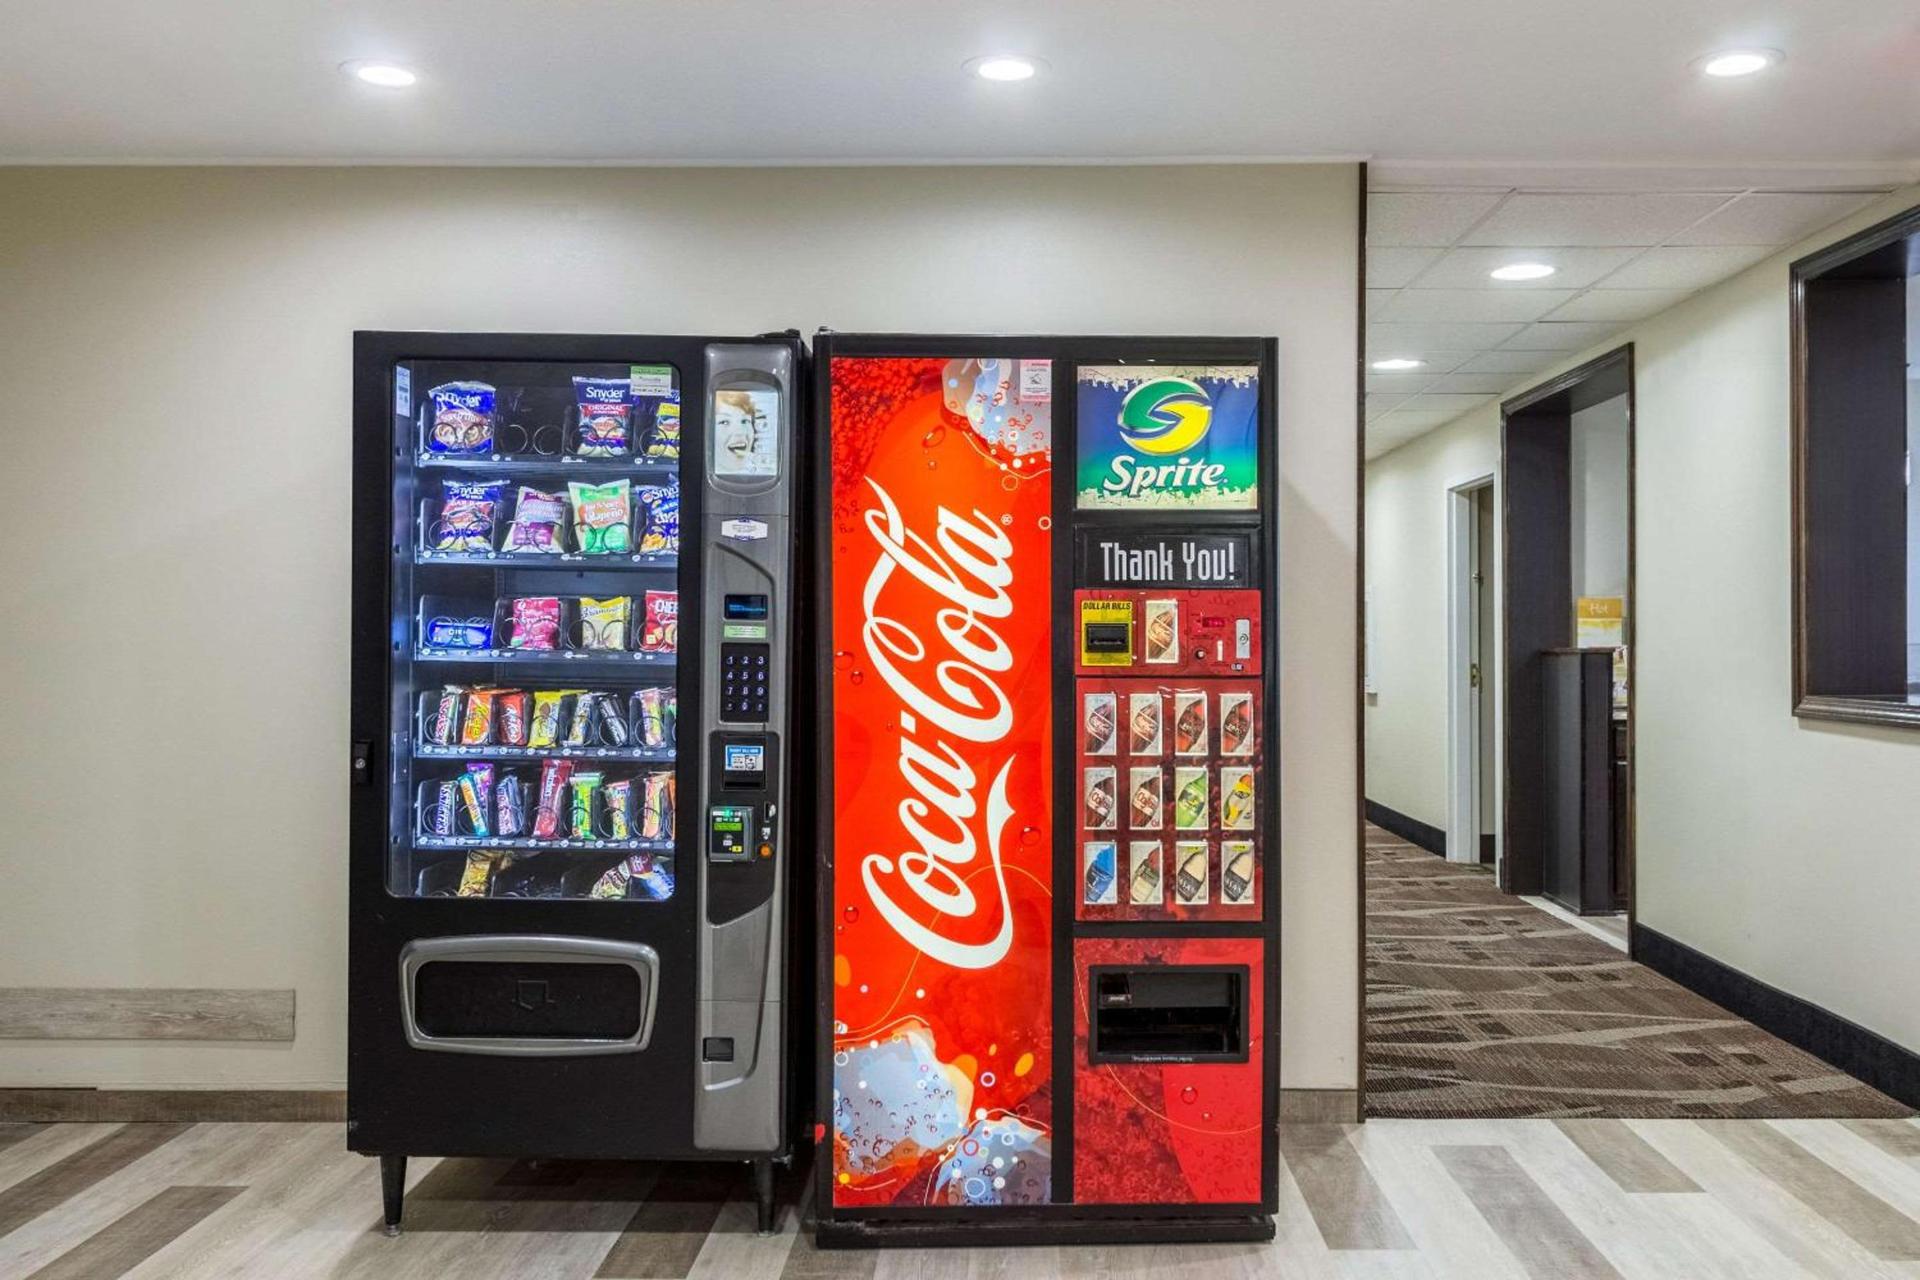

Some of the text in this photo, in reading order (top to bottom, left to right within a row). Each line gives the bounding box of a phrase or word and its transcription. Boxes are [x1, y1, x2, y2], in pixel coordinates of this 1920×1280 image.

[586, 386, 625, 400] Snyder
[1103, 455, 1228, 497] Sprite
[1100, 542, 1235, 581] Thank You!
[1083, 602, 1131, 610] DOLLAR BILLS
[862, 475, 1015, 970] Coca-Cola
